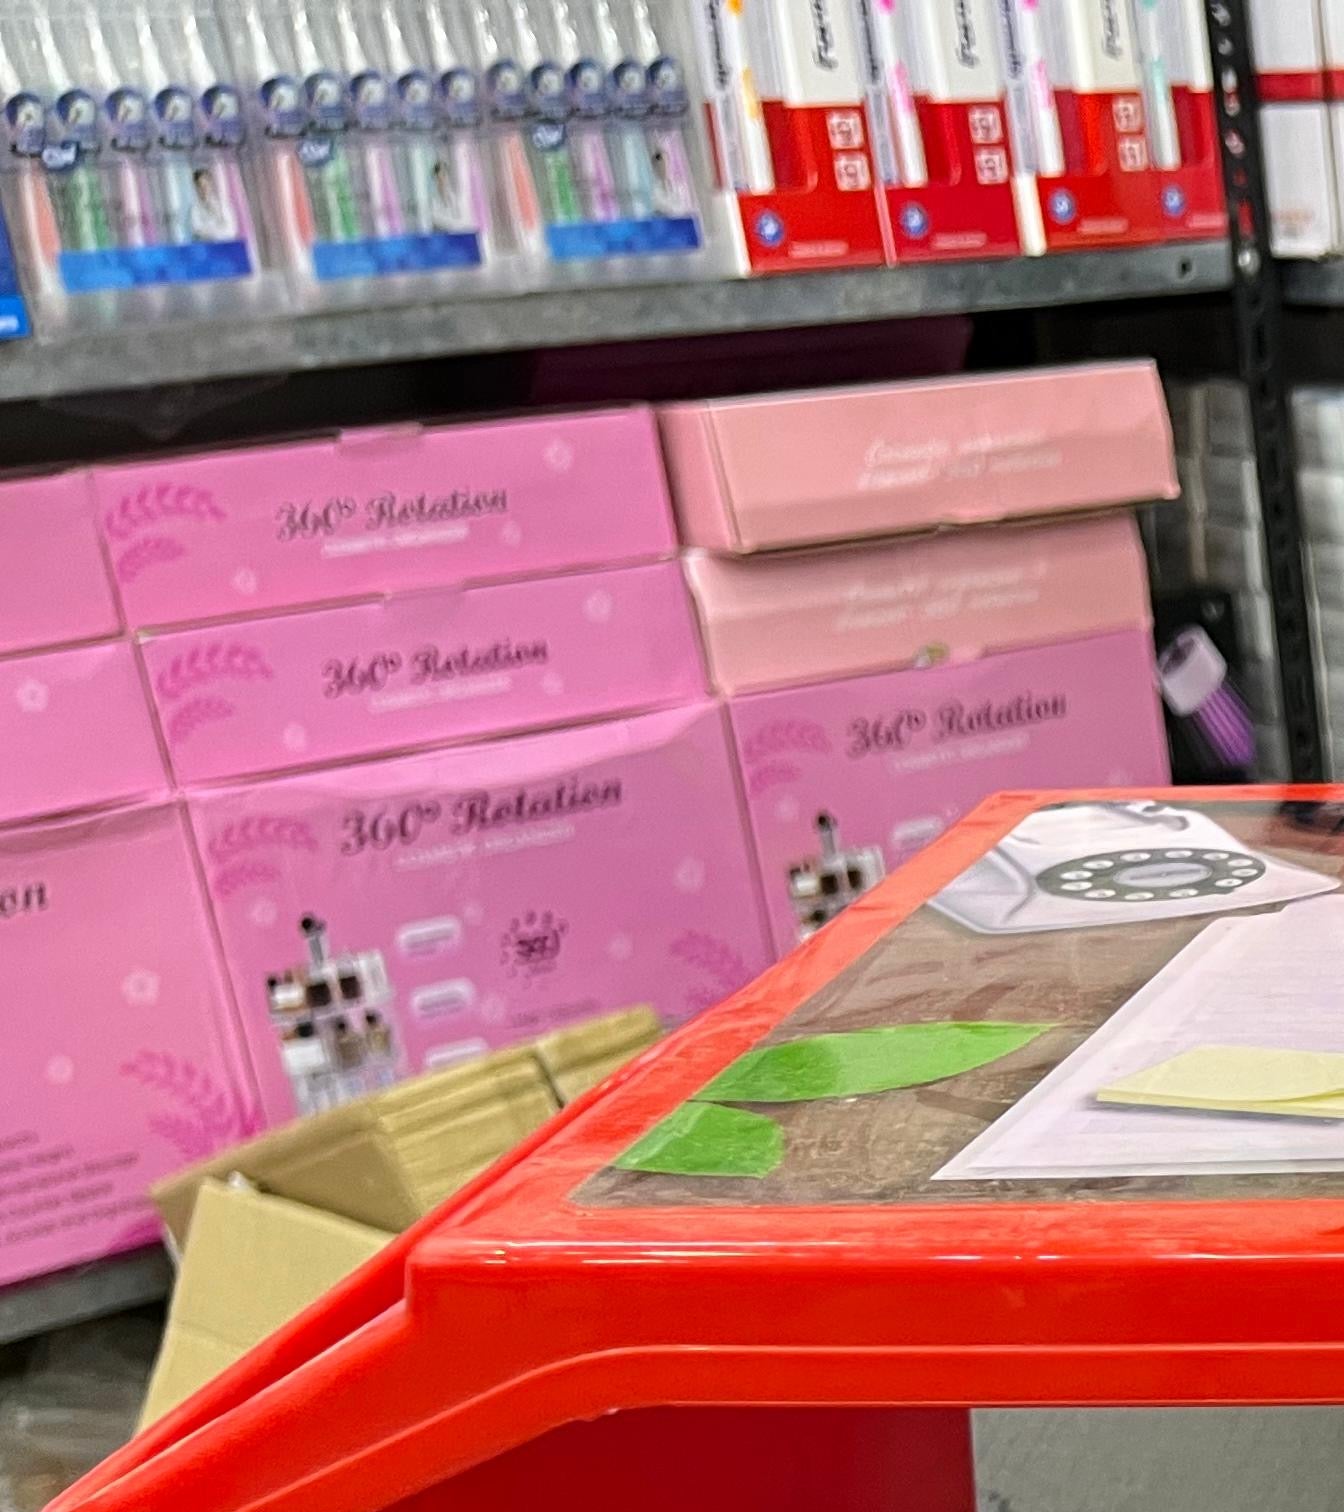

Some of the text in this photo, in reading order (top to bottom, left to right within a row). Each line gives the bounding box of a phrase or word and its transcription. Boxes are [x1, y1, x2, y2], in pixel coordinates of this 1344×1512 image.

[365, 487, 508, 531] Rotation
[410, 637, 549, 686] Rotation
[932, 690, 1068, 742] Rotation
[450, 776, 623, 836] Rotation
